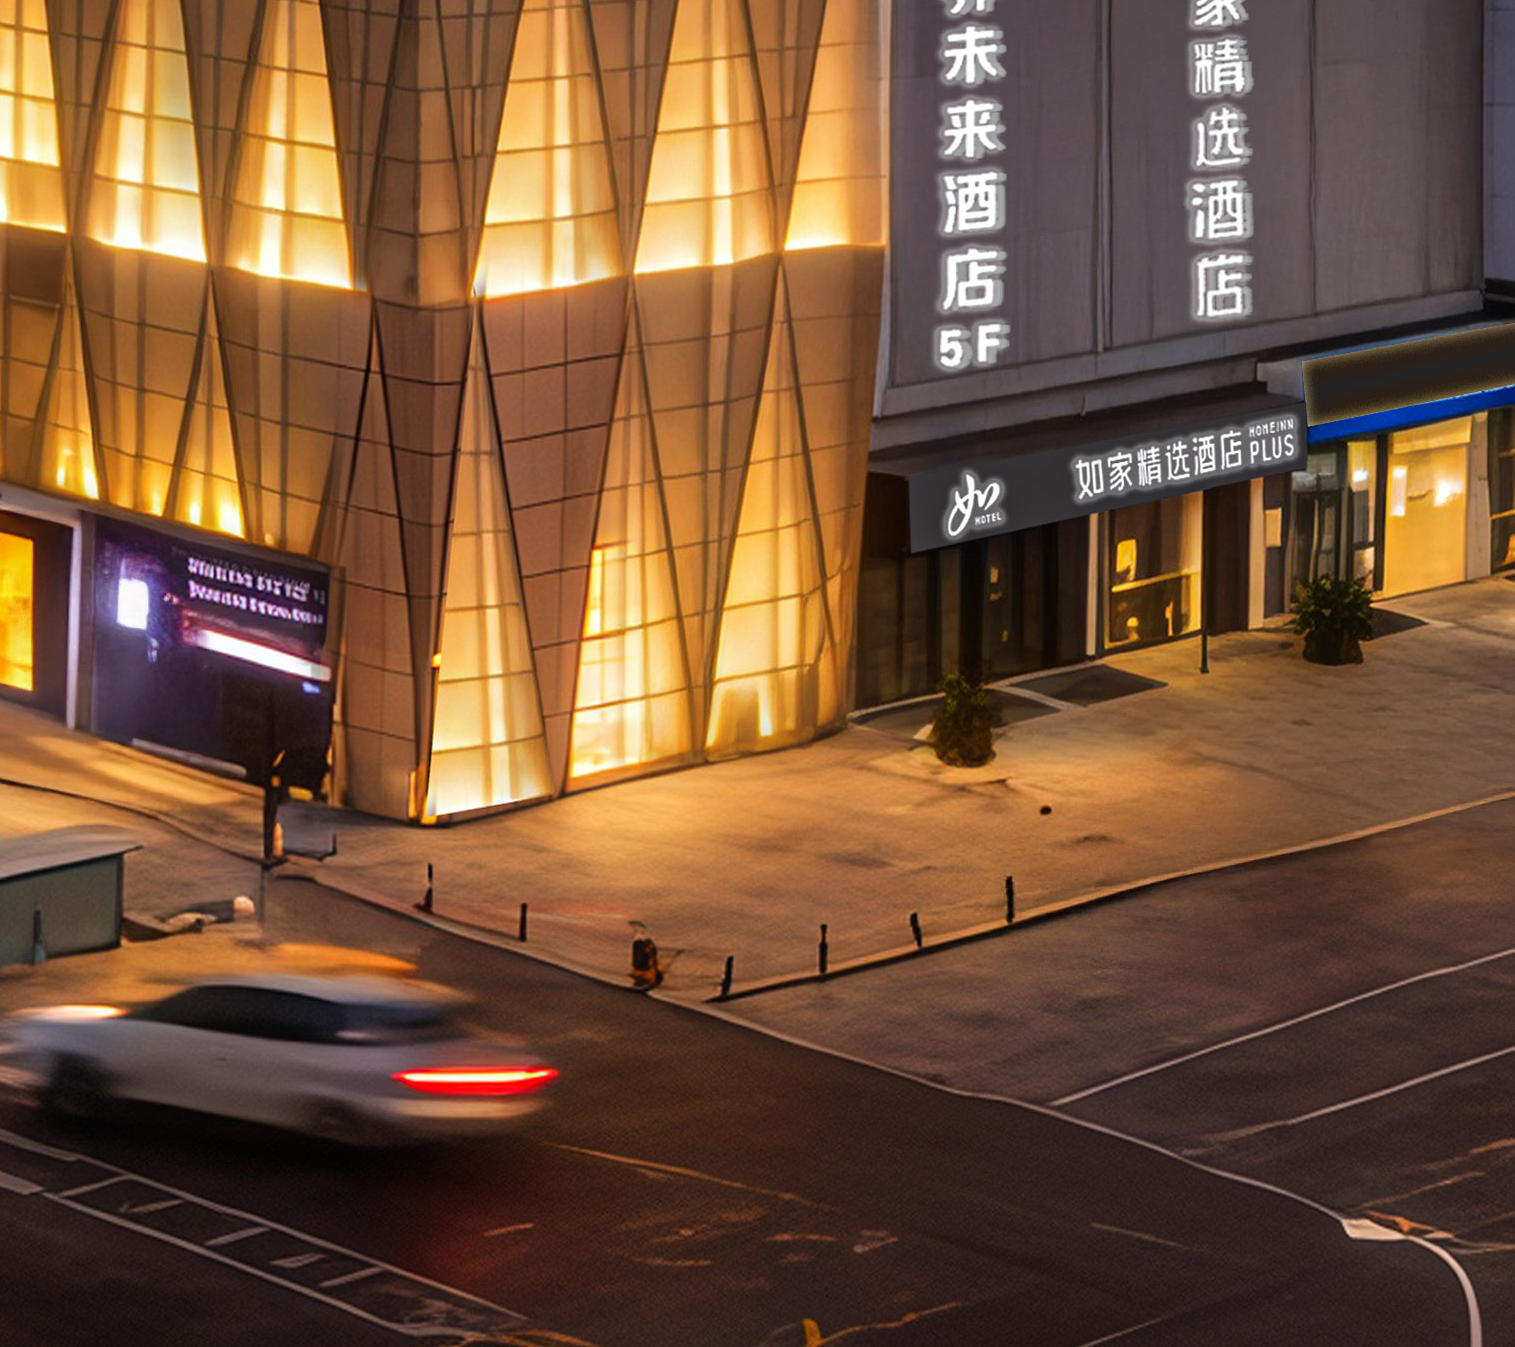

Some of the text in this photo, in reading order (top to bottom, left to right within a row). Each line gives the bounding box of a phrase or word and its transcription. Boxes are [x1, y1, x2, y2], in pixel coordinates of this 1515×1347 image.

[938, 322, 1006, 368] 5F
[1075, 429, 1295, 500] 如家精选酒店 PLUS
[974, 512, 1002, 526] HOTEL
